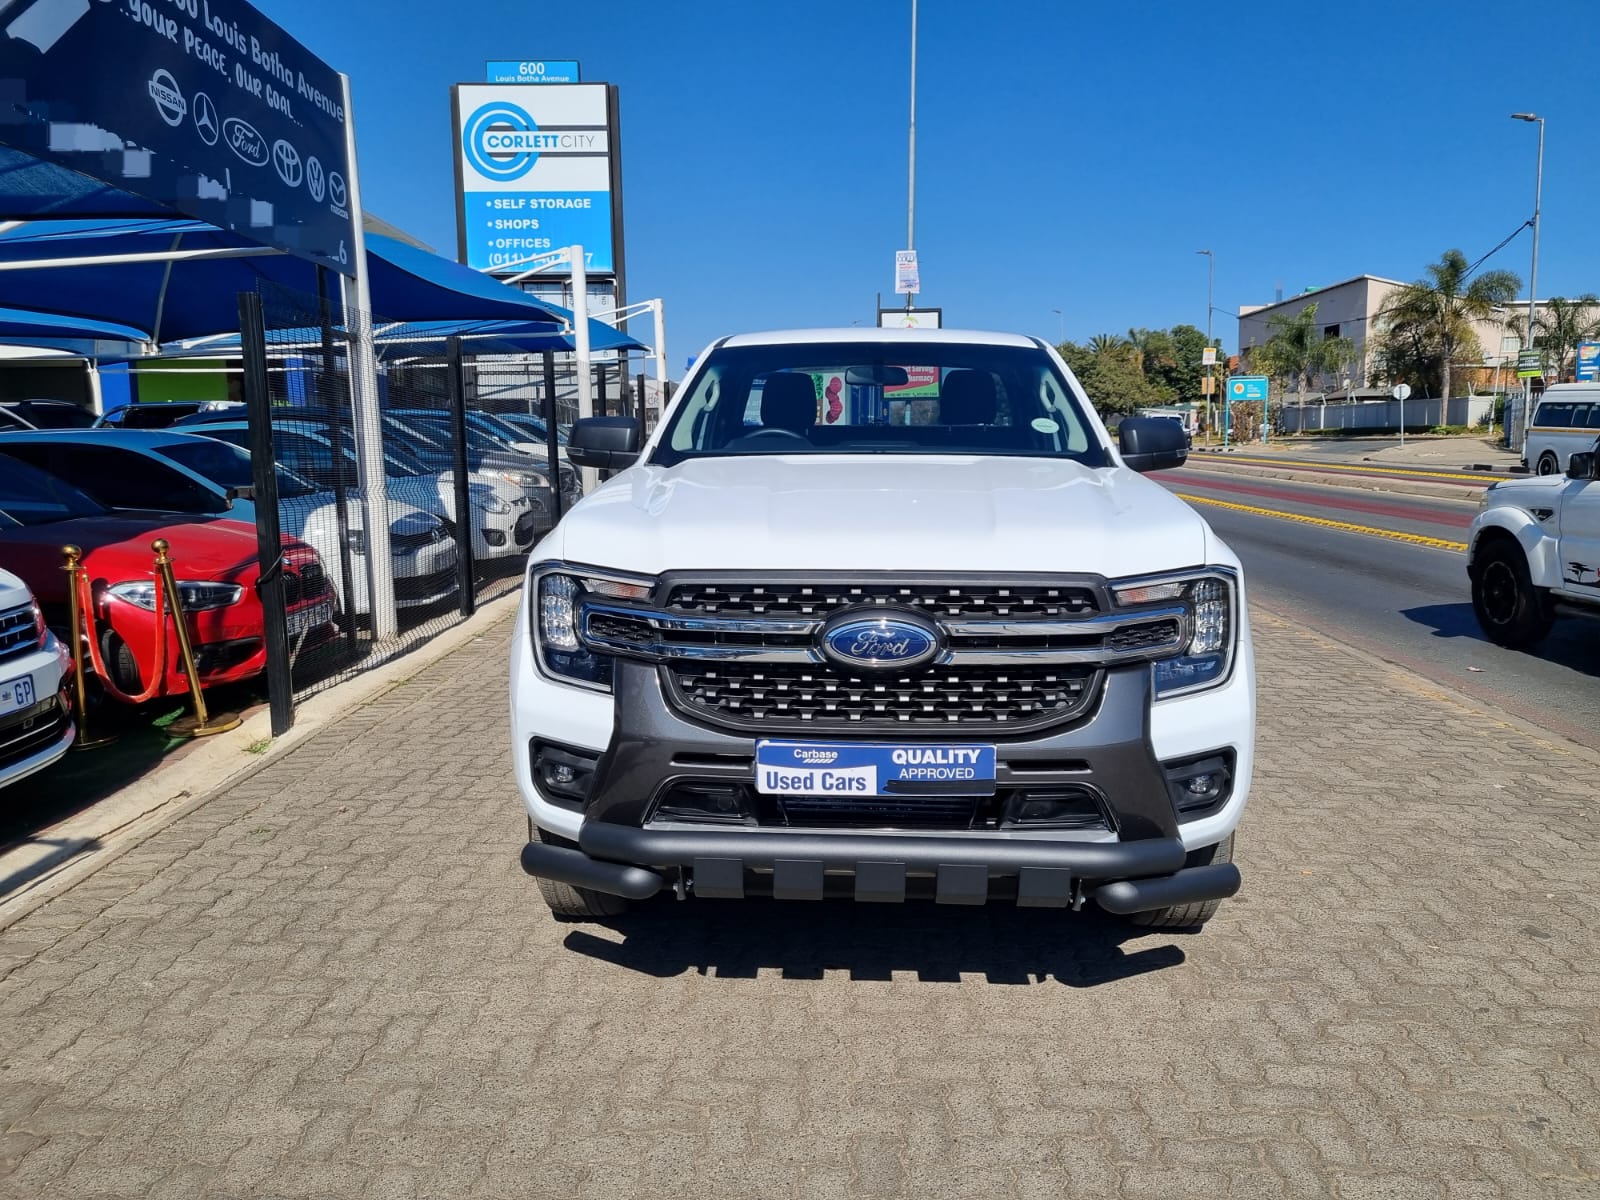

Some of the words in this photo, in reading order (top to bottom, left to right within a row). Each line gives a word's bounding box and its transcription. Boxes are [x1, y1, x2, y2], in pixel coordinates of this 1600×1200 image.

[203, 0, 248, 55] Louis
[251, 35, 294, 88] Botha
[297, 71, 344, 123] Avenue
[519, 62, 545, 75] 600
[235, 62, 263, 98] OUR
[495, 75, 516, 83] Louis
[517, 75, 540, 83] Botha
[541, 75, 570, 83] Avenue
[150, 85, 186, 111] NISSAN
[232, 127, 261, 159] Ford
[494, 199, 526, 209] SELF
[530, 199, 592, 209] STORAGE
[495, 219, 540, 230] SHOPS
[495, 238, 551, 249] OFFICES
[850, 630, 909, 656] Ford
[14, 681, 31, 705] GP
[793, 748, 839, 760] Carbase
[892, 749, 981, 765] QUALITY
[765, 770, 814, 791] Used
[821, 771, 867, 792] Cars
[899, 767, 975, 779] APPROVED
